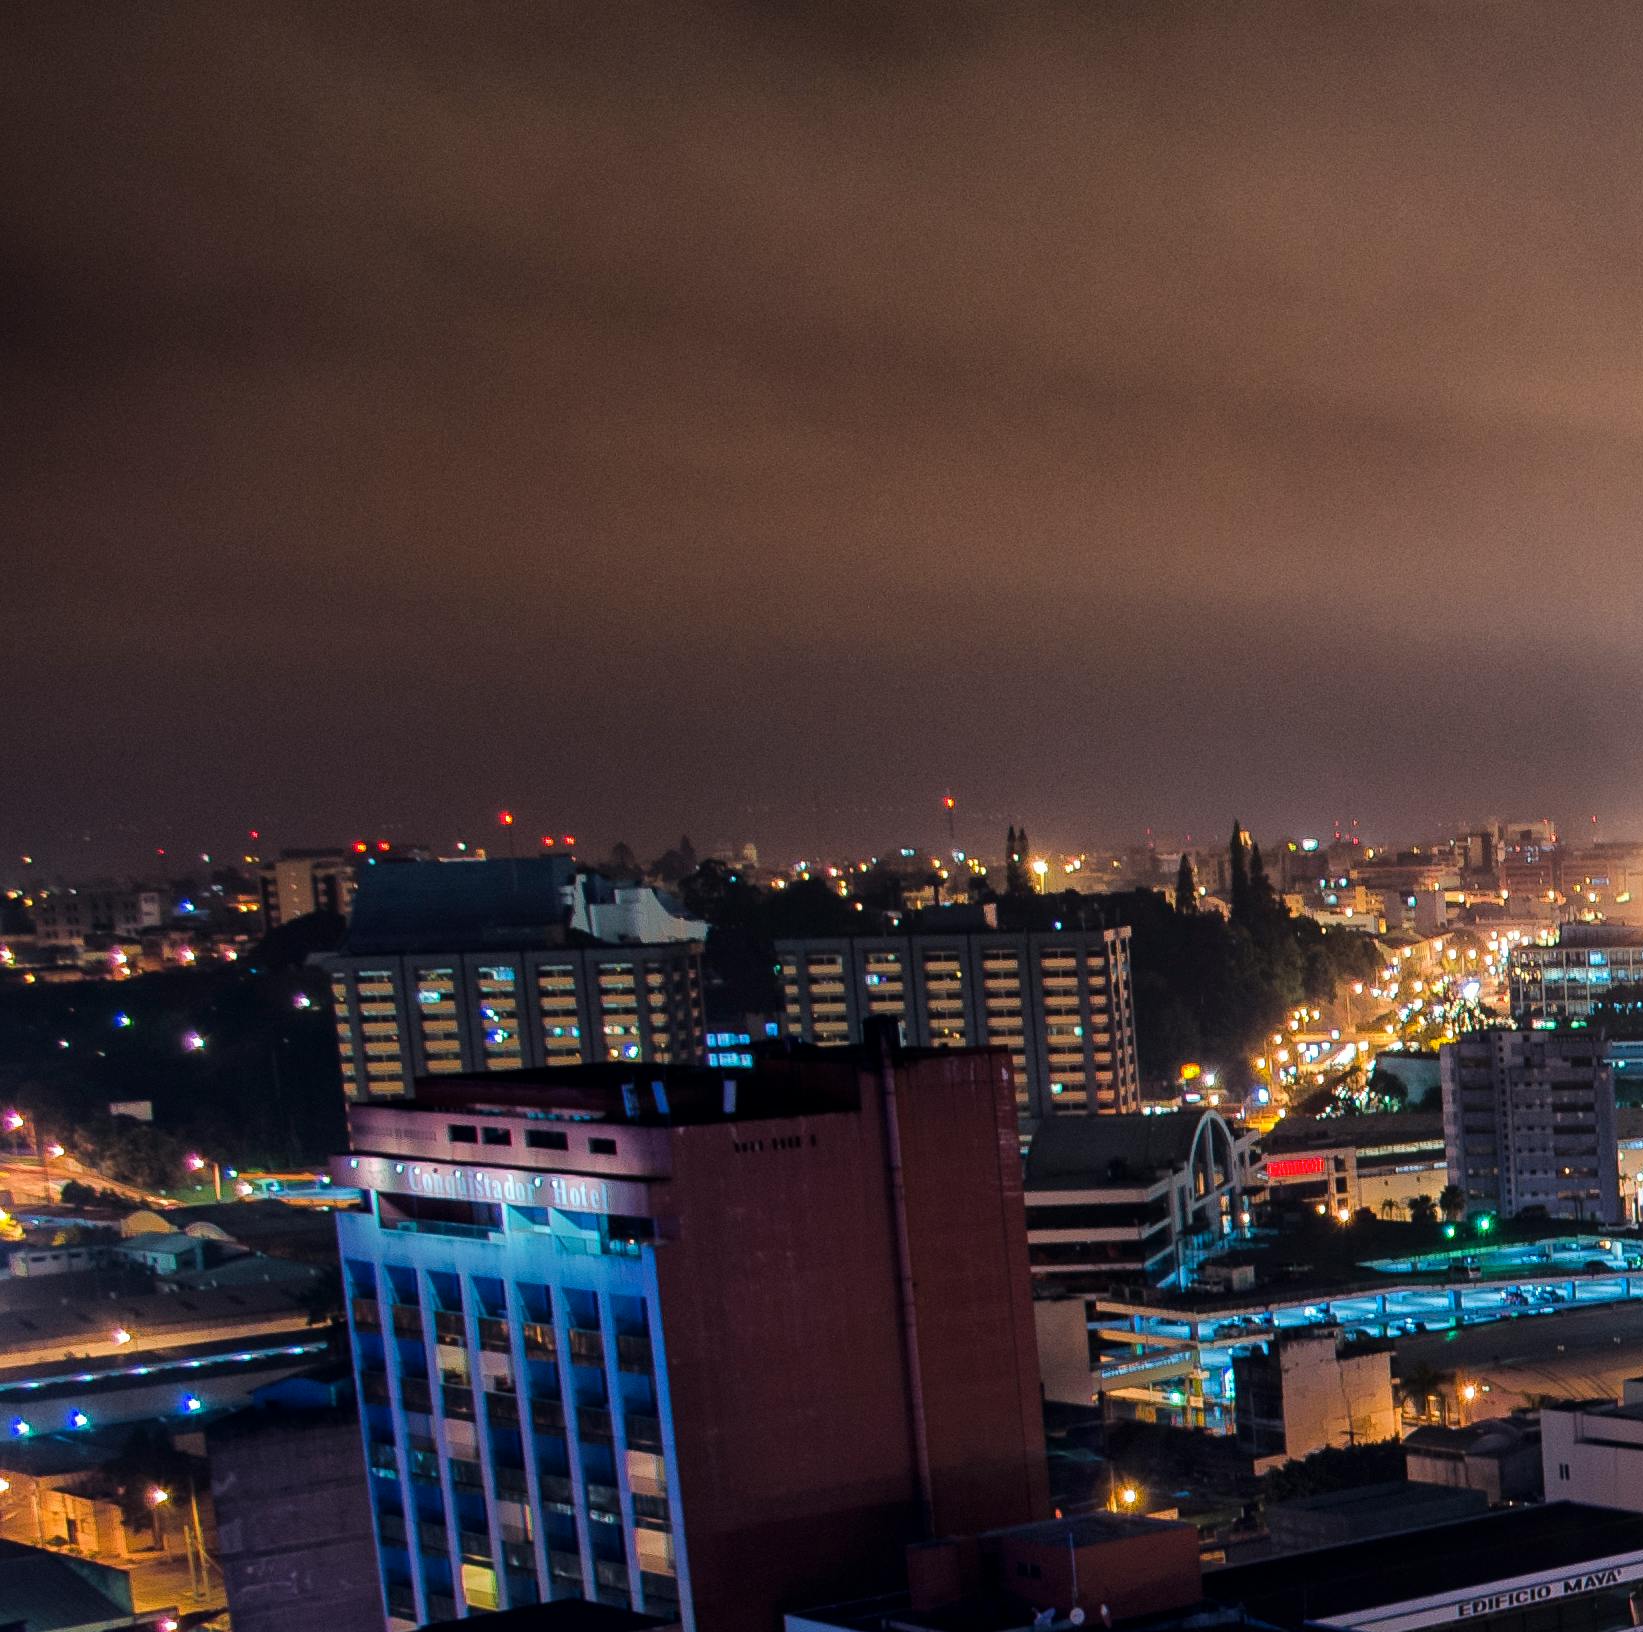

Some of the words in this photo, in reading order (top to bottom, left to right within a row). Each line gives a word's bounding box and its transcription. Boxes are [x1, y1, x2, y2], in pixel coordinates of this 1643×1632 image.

[407, 1167, 537, 1203] Conquistador
[552, 1175, 610, 1209] Hotel
[1457, 1585, 1552, 1617] EDIFICIO
